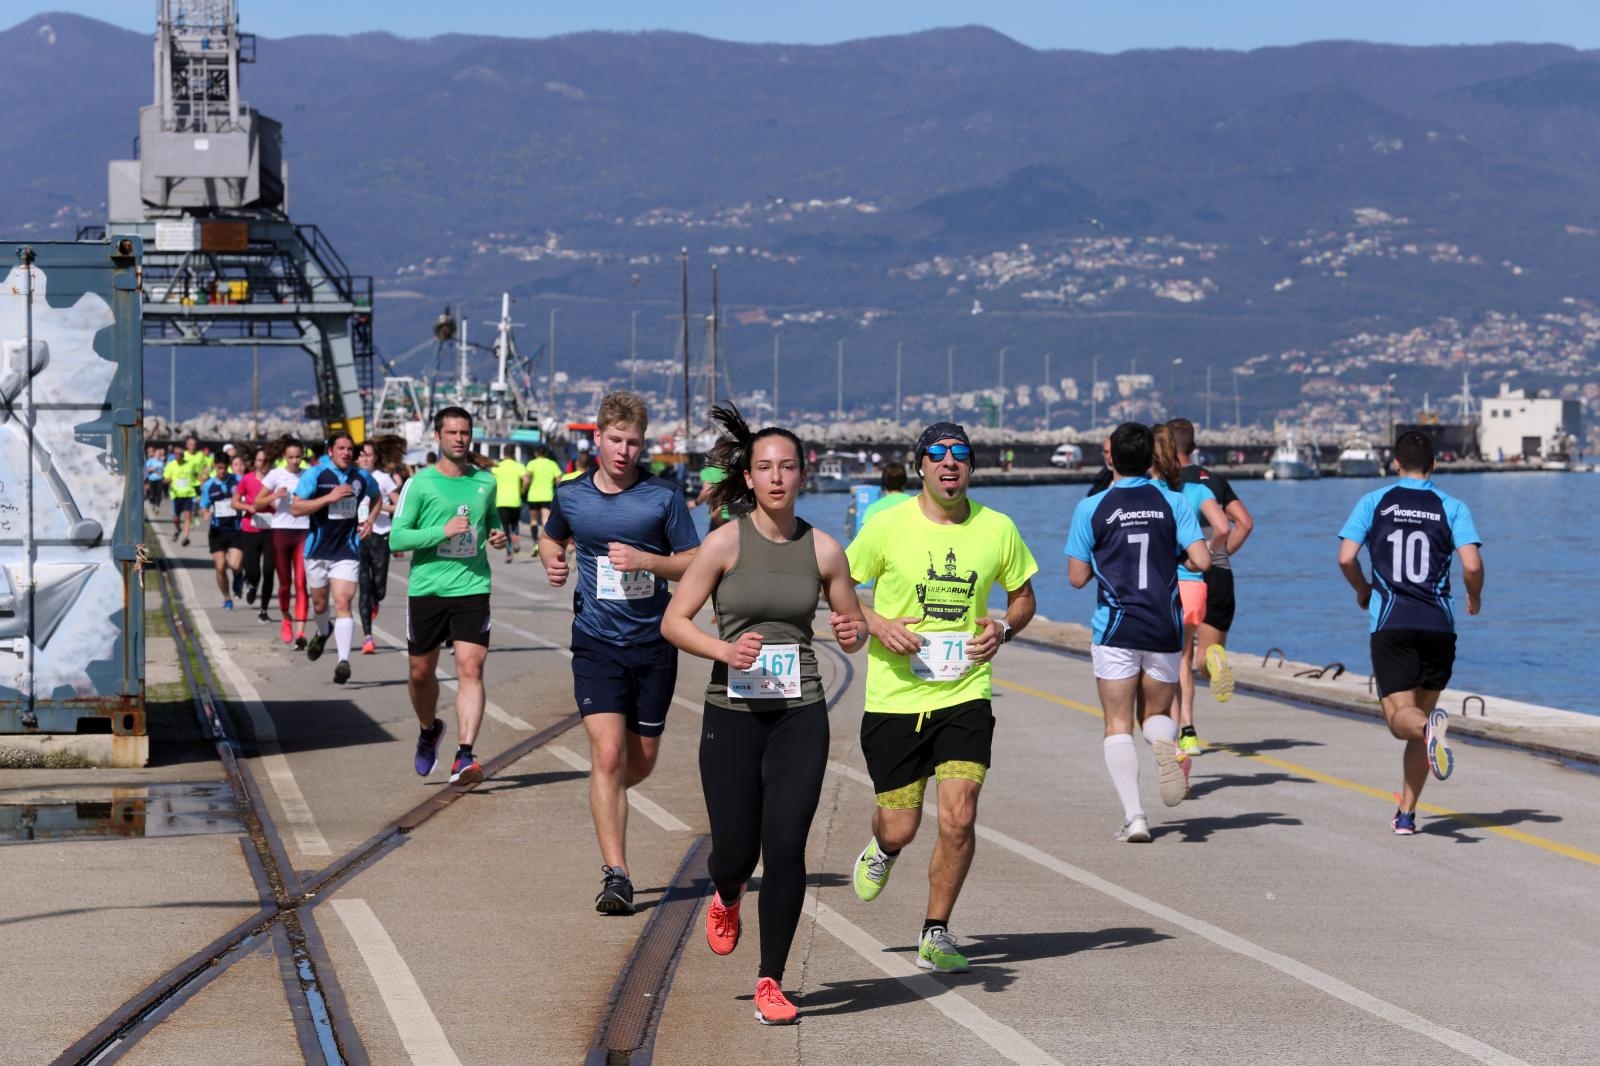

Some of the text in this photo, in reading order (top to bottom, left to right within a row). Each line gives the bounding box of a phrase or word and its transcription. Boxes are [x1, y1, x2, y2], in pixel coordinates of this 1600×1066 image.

[1119, 511, 1164, 521] WORCESTER
[1394, 509, 1440, 521] WORCESTER
[459, 532, 472, 546] 24
[1127, 533, 1149, 590] 7
[1386, 529, 1430, 583] 10
[942, 640, 963, 661] 71
[758, 653, 795, 677] 167
